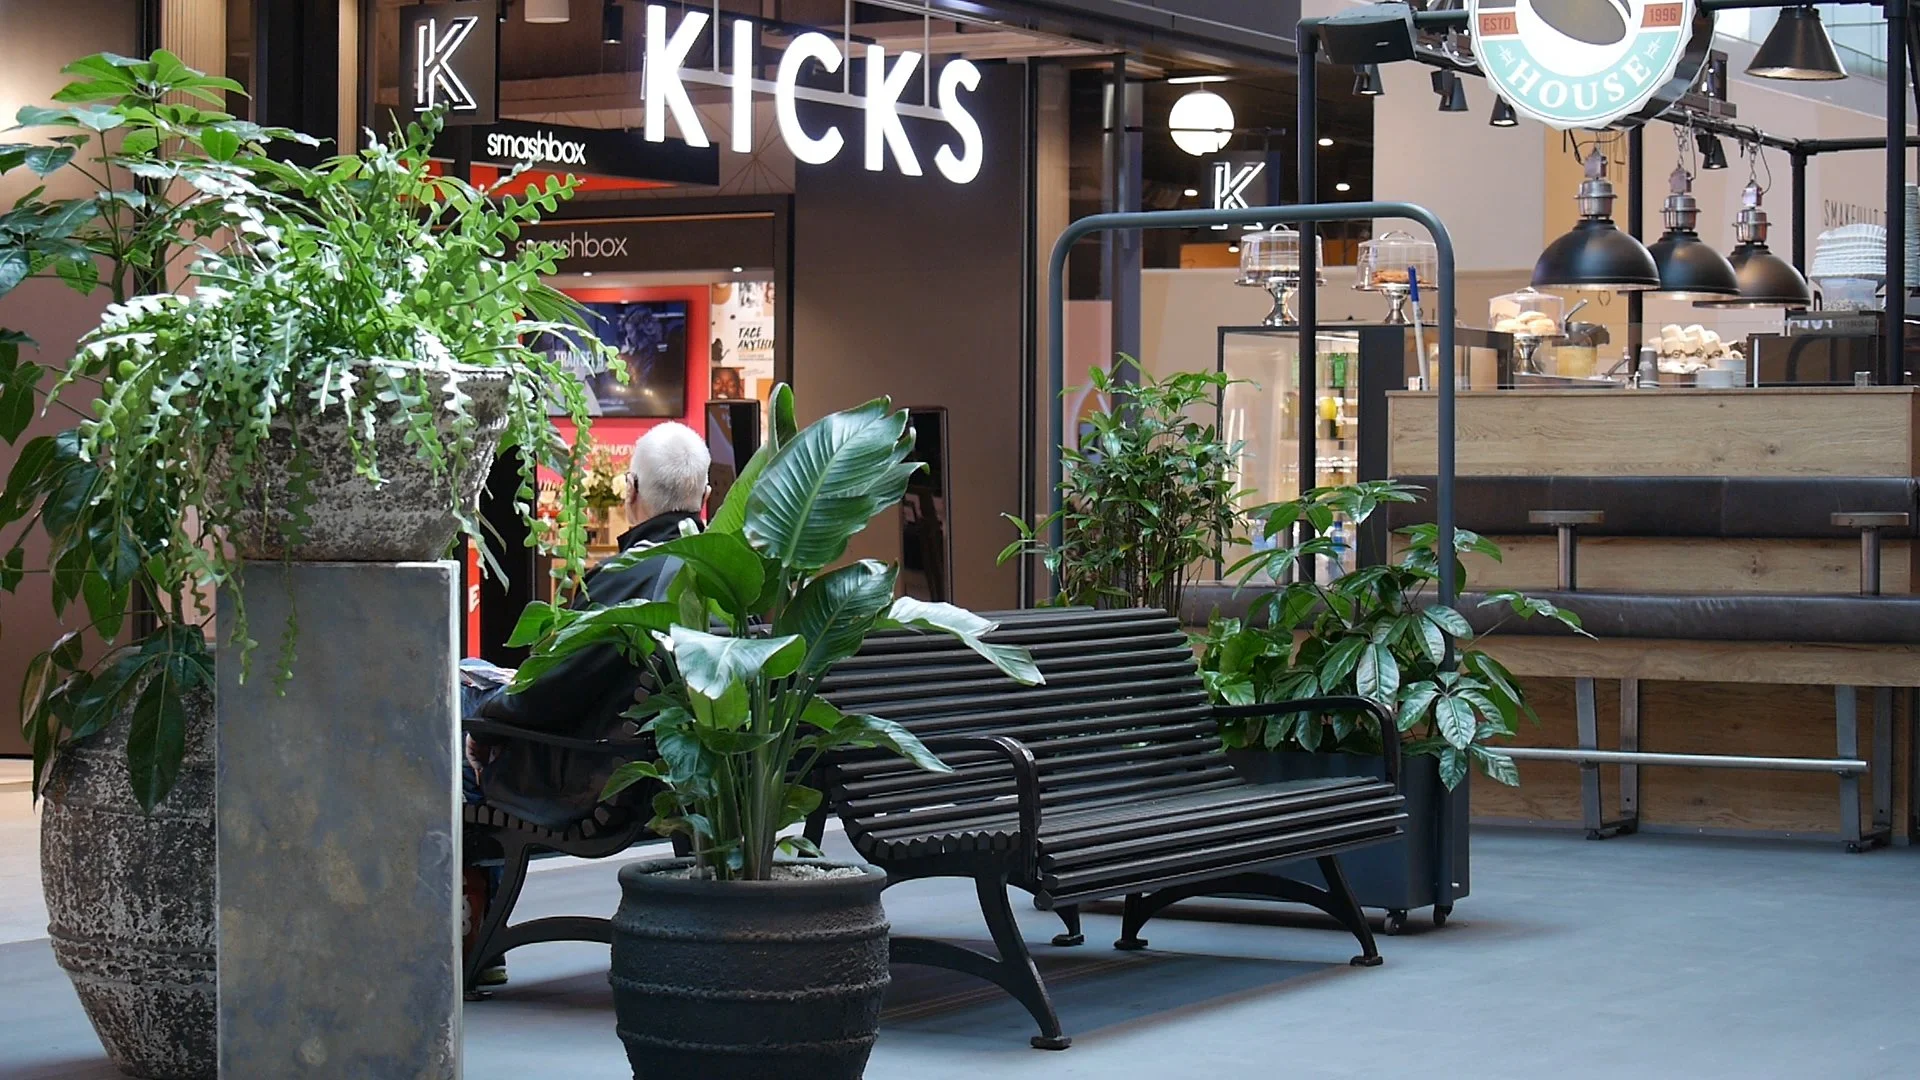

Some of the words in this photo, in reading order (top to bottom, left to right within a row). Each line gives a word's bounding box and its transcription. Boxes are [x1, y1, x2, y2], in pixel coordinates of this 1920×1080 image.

[1482, 16, 1511, 31] ESTD
[1650, 7, 1677, 22] 1996
[413, 15, 478, 112] K
[1506, 54, 1652, 111] HOUSE
[644, 4, 984, 184] KICKS
[487, 130, 587, 165] smashbox
